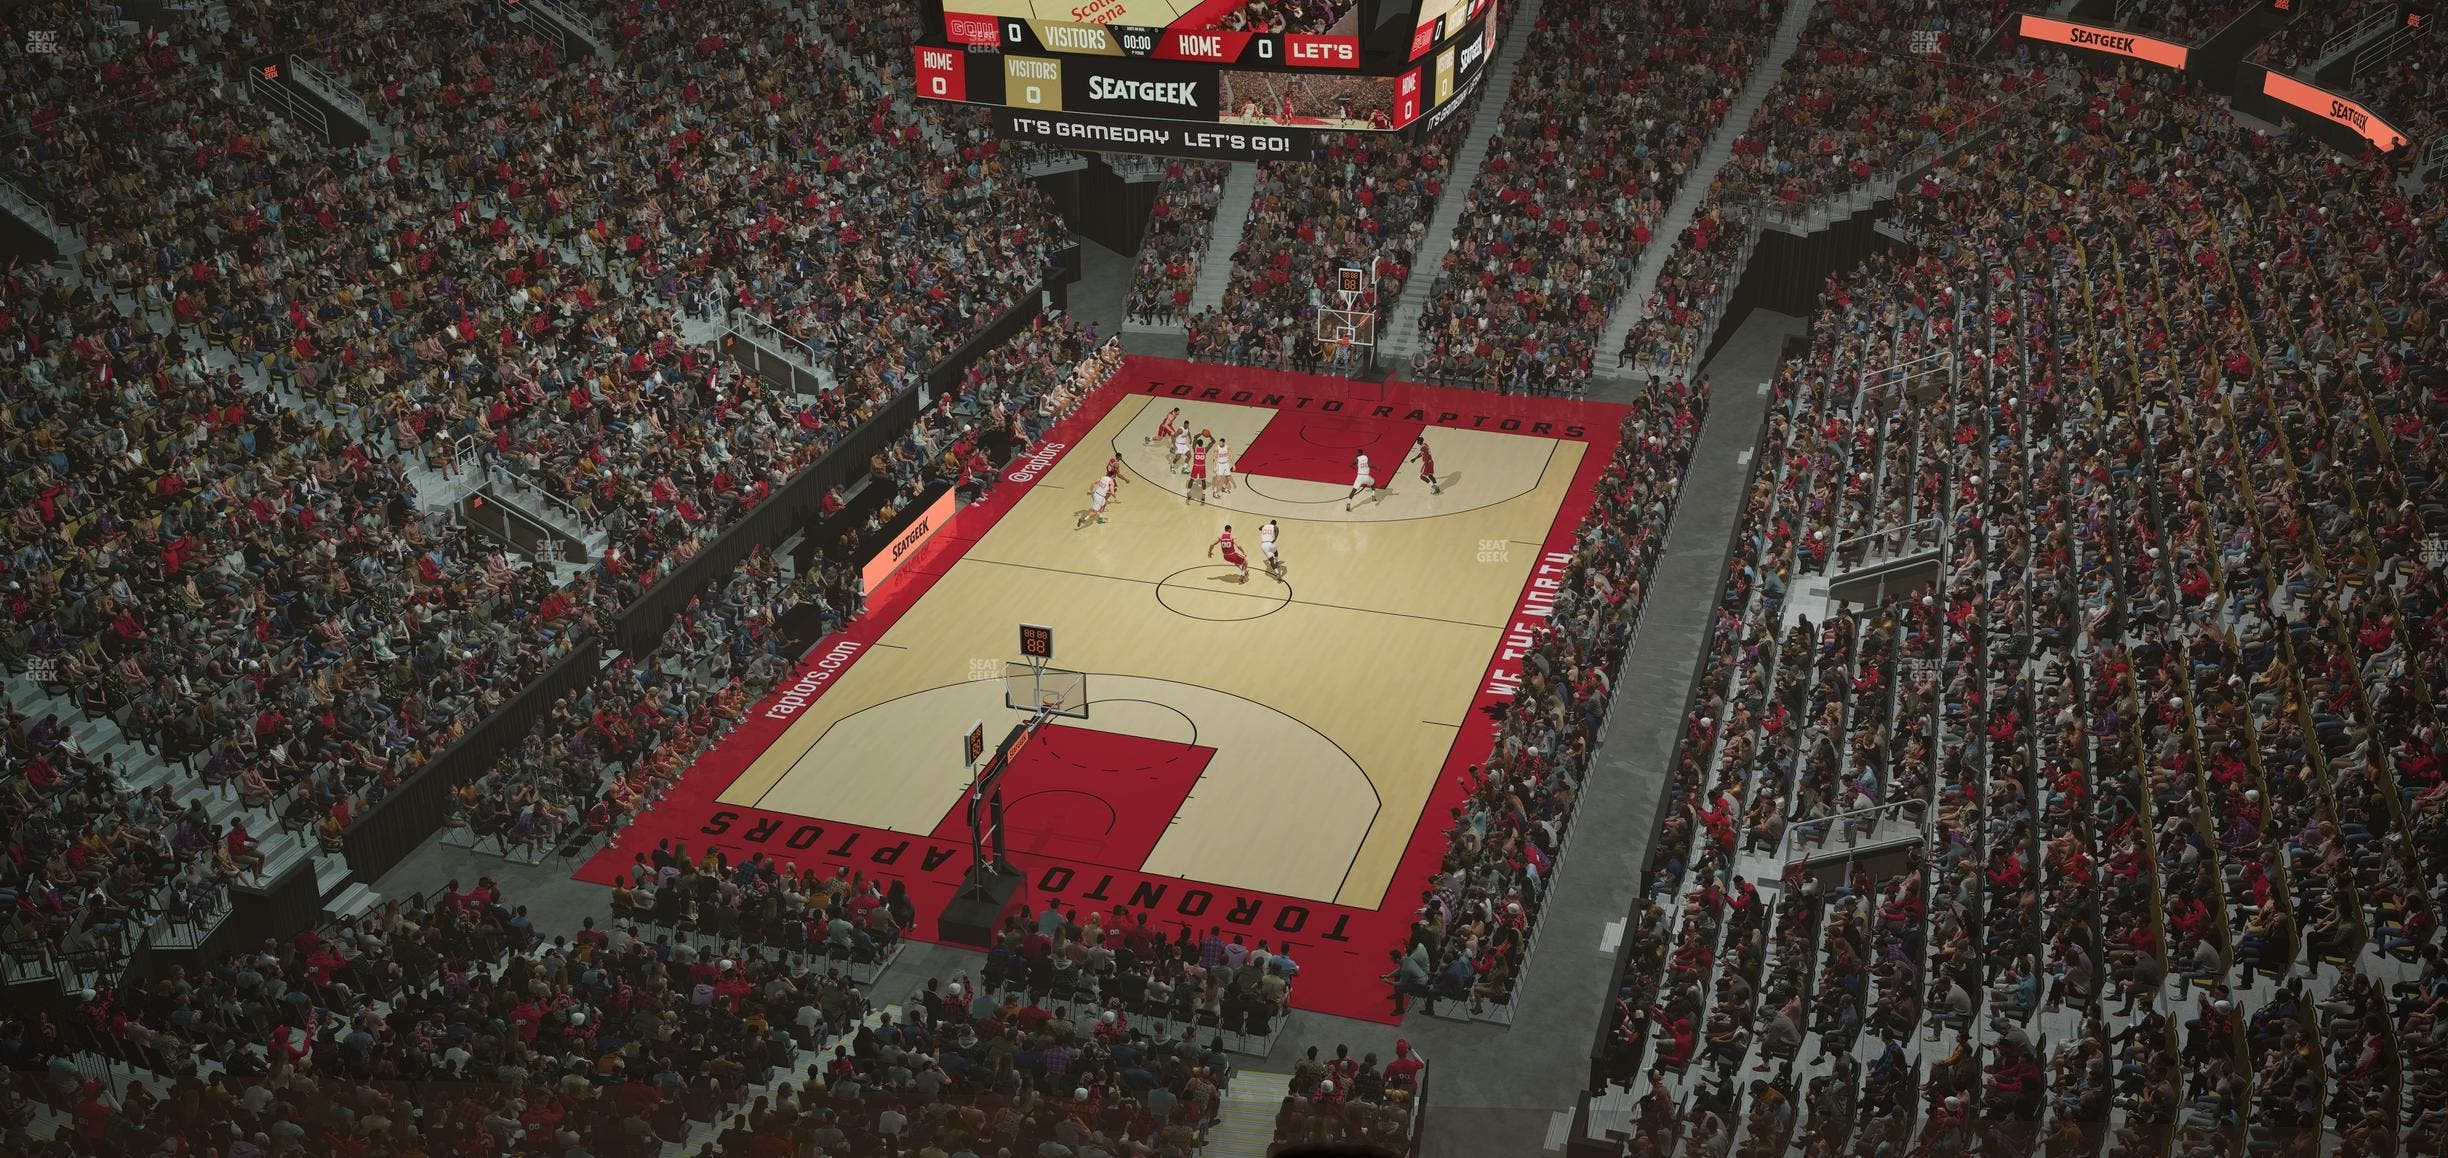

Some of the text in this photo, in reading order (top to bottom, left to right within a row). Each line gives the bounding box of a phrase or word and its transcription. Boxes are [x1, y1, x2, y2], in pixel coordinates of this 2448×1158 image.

[1044, 25, 1106, 50] VISITORS
[1124, 34, 1151, 50] 00:00
[1179, 34, 1222, 57] HOME
[1293, 42, 1353, 60] LET'S
[2070, 27, 2135, 53] SEATGEEK
[923, 51, 953, 71] HOME
[1008, 59, 1057, 80] VISITORS
[1088, 75, 1198, 108] SEATGEEK
[2330, 100, 2369, 134] SEATGEEK
[1013, 117, 1291, 152] IT'S GAMEDAY LET'S GO!
[1146, 381, 1586, 438] TORONTO RAPTORS
[1008, 442, 1066, 483] @raptors
[892, 516, 929, 562] SEATGEEK
[1027, 638, 1045, 653] 88
[765, 641, 862, 720] raptors.com
[700, 811, 1351, 942] TORONTO APTORS
